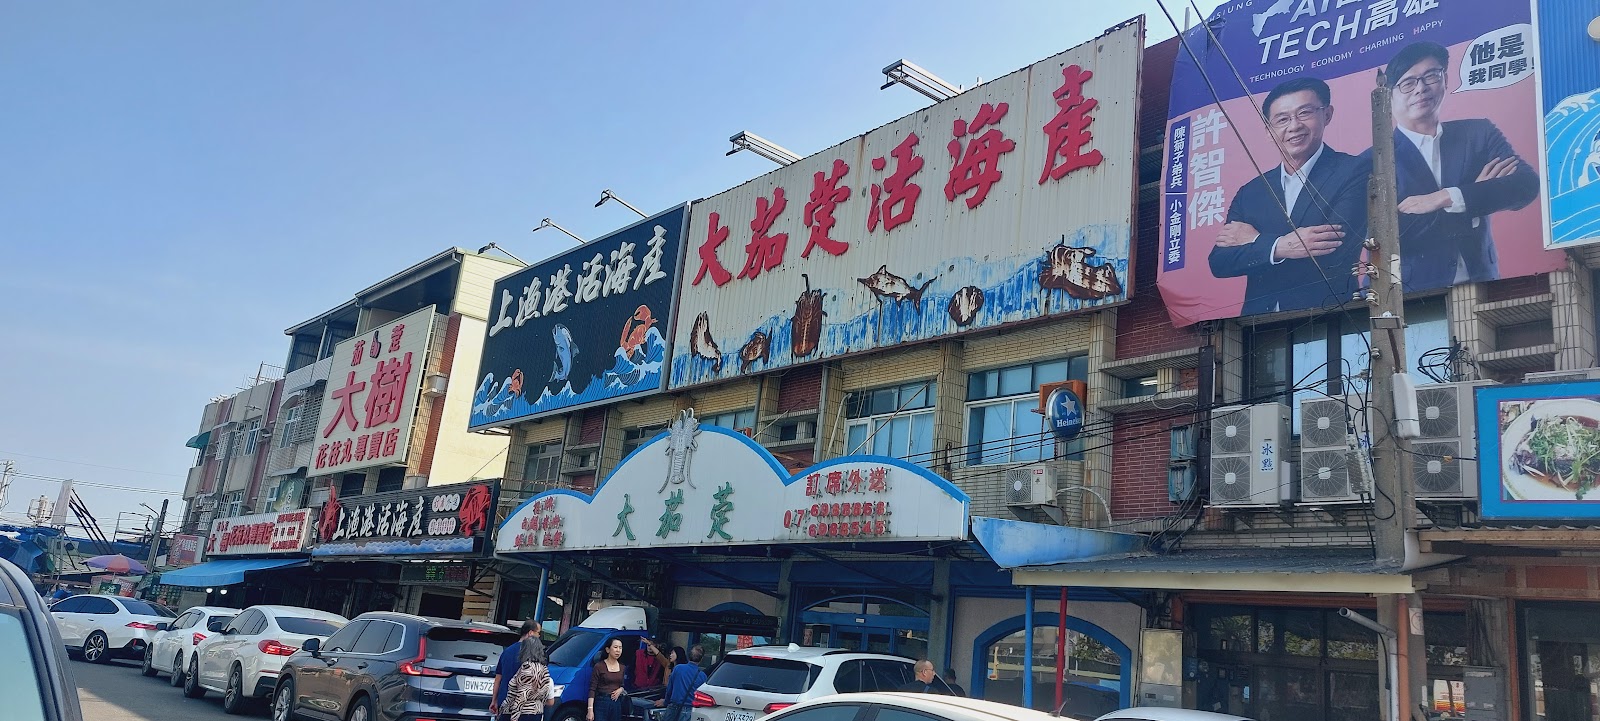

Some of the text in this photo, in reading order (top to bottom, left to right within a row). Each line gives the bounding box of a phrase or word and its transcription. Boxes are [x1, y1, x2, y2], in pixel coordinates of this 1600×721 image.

[1250, 20, 1444, 83] TECHNOLOGY ECONOMY CHARMING HAPPY
[1470, 32, 1524, 66] 他是
[1188, 108, 1228, 230] 許智傑
[1168, 126, 1186, 264] 陳菊子弟兵 小金剛立委
[323, 351, 412, 439] 大樹
[315, 427, 399, 469] 花枝丸專賣店
[1261, 443, 1274, 471] 冰點
[805, 467, 885, 497] 訂席外送
[783, 509, 805, 529] 07
[465, 680, 495, 692] BVN-372
